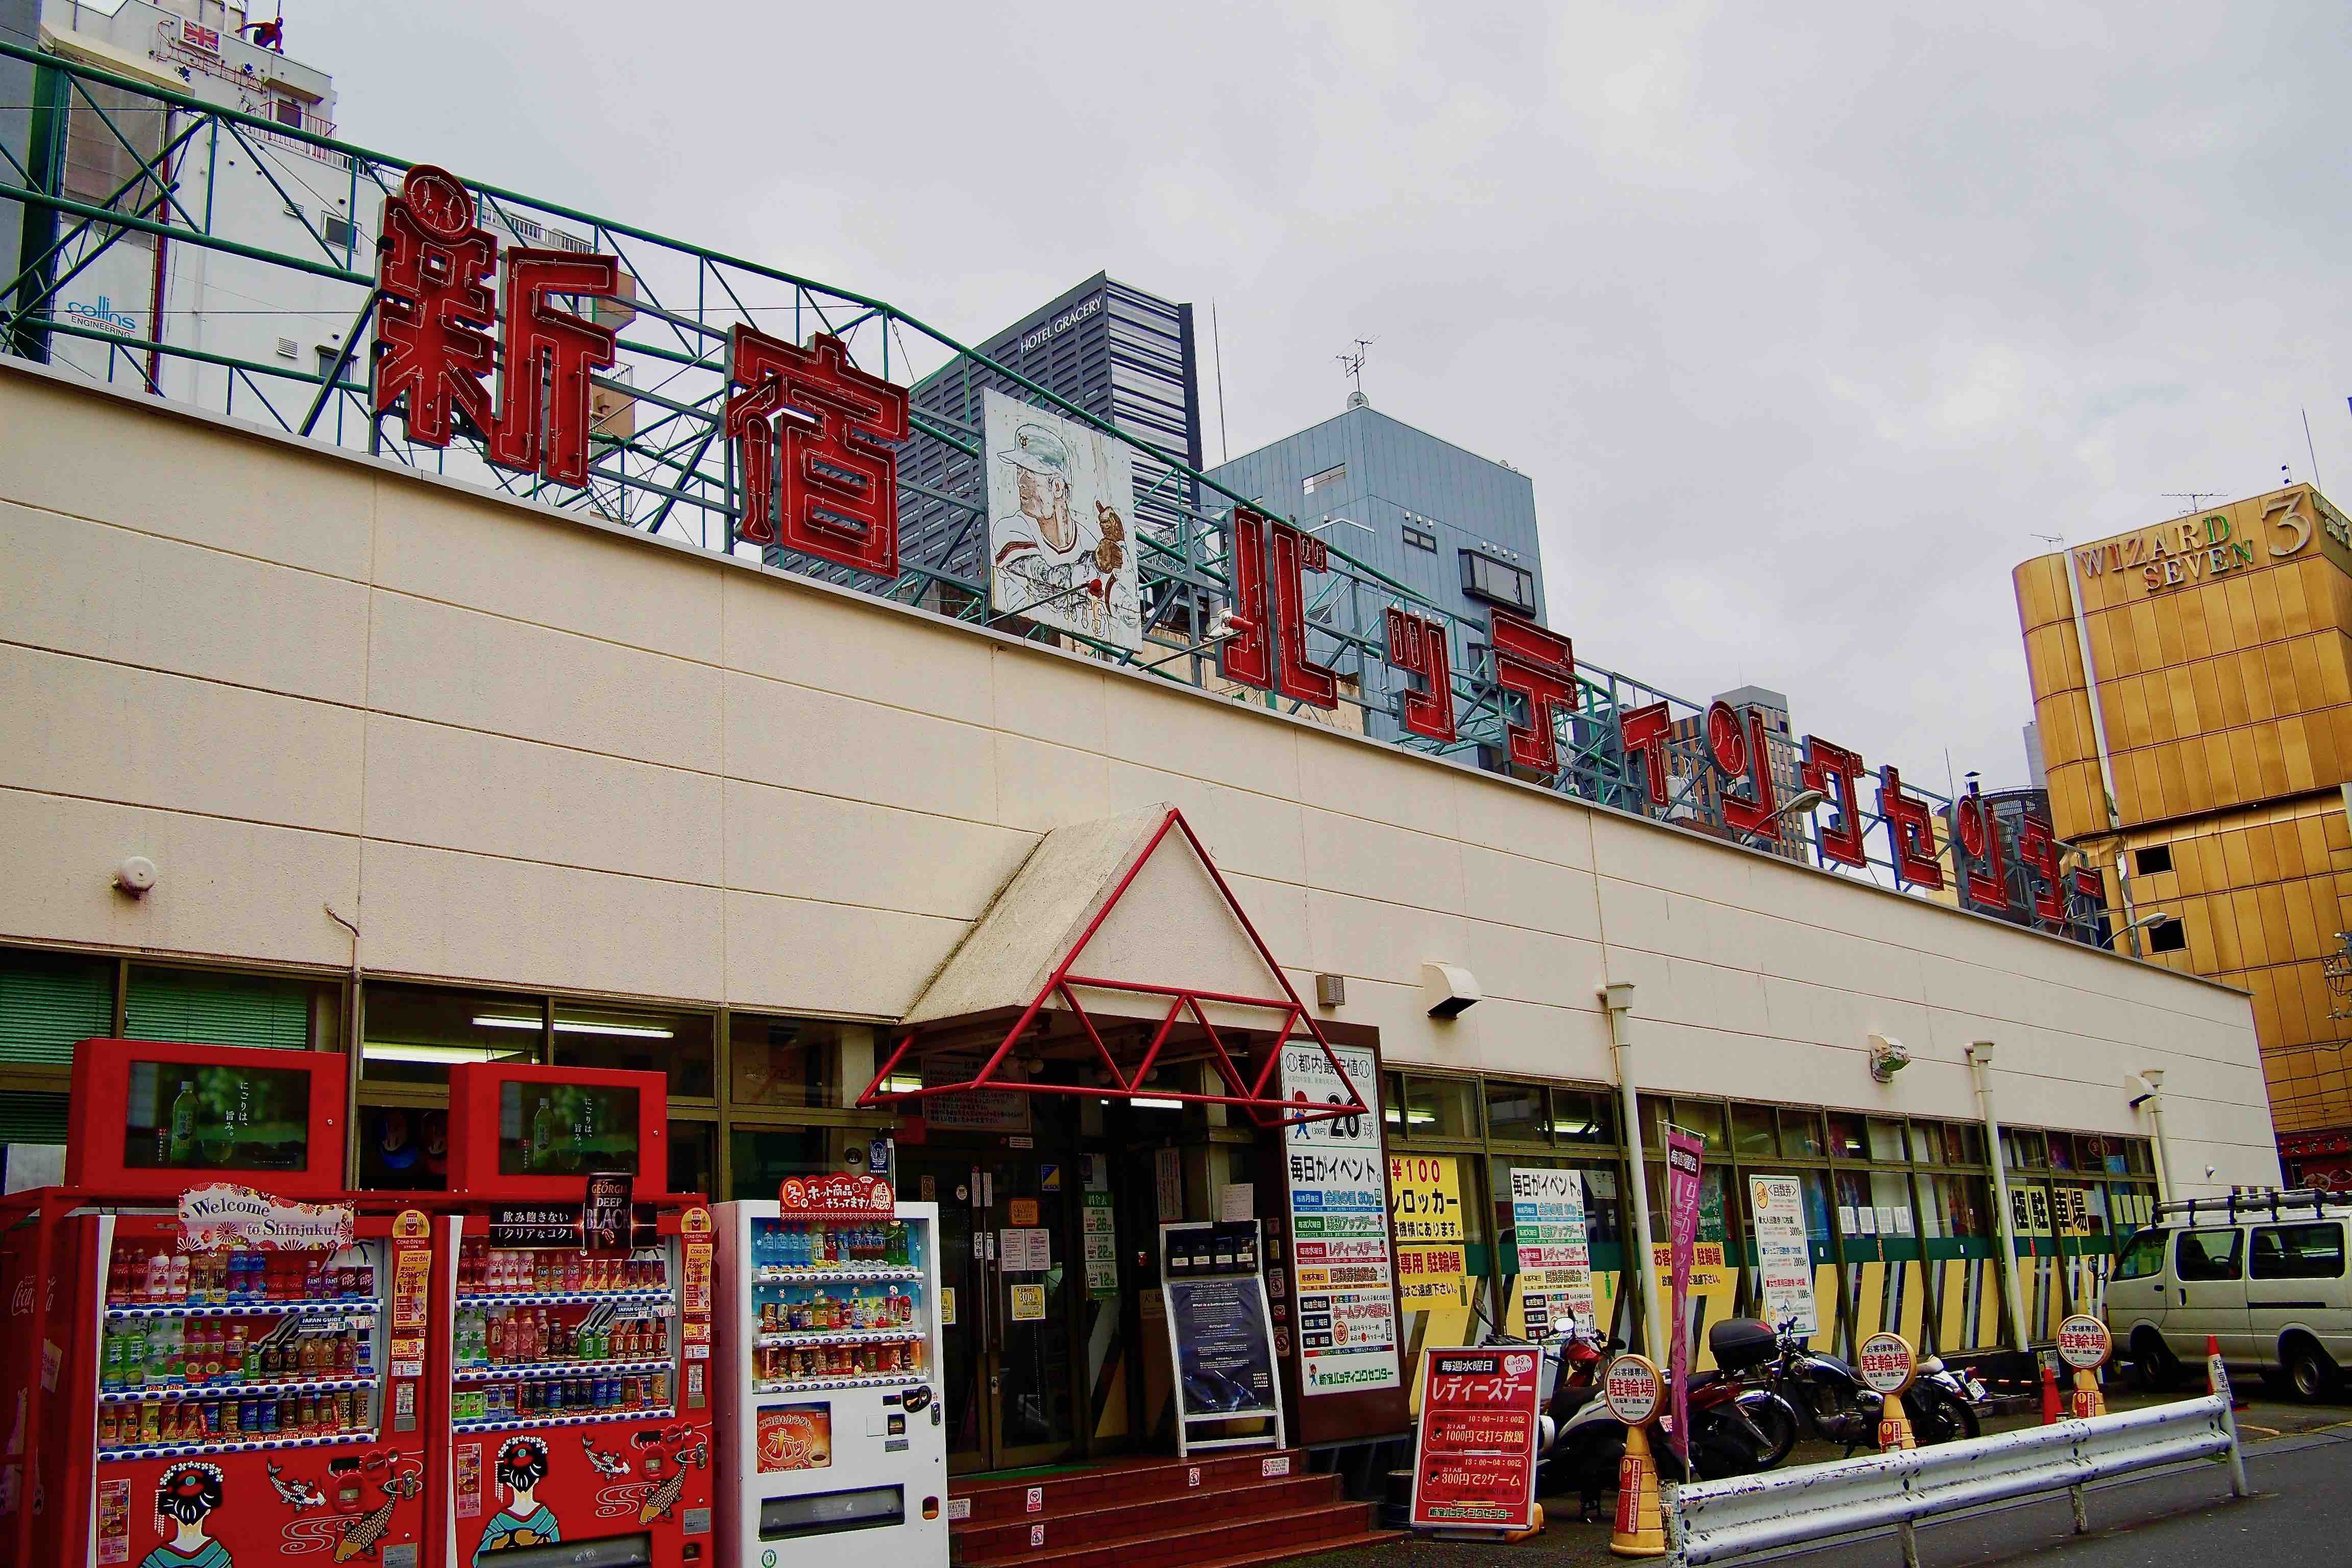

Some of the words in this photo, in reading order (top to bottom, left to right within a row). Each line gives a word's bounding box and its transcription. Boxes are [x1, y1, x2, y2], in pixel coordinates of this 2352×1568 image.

[68, 296, 136, 329] collins
[71, 315, 131, 338] ENGINEERING
[1021, 326, 1054, 354] HOTEL
[1054, 296, 1101, 332] GRACERY
[374, 163, 910, 579] 新宿
[1216, 505, 2103, 923] バッティングセンター
[2076, 514, 2230, 578] WIZARD
[2261, 491, 2311, 556] 3
[2144, 538, 2254, 591] SEVEN
[225, 1110, 235, 1137] 旨み。
[1326, 1092, 1361, 1140] 26
[1363, 1122, 1375, 1139] 球
[574, 1123, 582, 1146] 旨み。
[1290, 1154, 1382, 1183] 毎日がイベント。
[788, 1184, 801, 1204] 冬
[808, 1184, 852, 1199] ホット商品
[1512, 1173, 1581, 1197] 毎日がイベント。
[190, 1197, 270, 1217] Welcome
[597, 1197, 622, 1207] DEEP
[503, 1211, 569, 1223] 飲み飽きない
[586, 1208, 630, 1230] BLACK
[247, 1224, 260, 1236] to
[263, 1218, 339, 1237] Shinjuku!
[1427, 1251, 1461, 1273] 駐輪場
[1866, 1343, 1901, 1353] お客様専用
[2060, 1333, 2106, 1350] 駐輪場
[1442, 1360, 1493, 1372] 毎週水曜日
[1506, 1356, 1531, 1366] Lady's
[1861, 1353, 1909, 1372] 駐輪場
[1319, 1368, 1393, 1385] 新宿バッティングセンター
[1613, 1367, 1648, 1377] お客様専用
[1432, 1375, 1533, 1401] レディースデー
[1609, 1378, 1655, 1398] 駐輪場
[765, 1428, 804, 1460] ホッ
[1445, 1430, 1524, 1443] 1000円で打ち放題
[1442, 1473, 1521, 1486] 300円で2ゲーム
